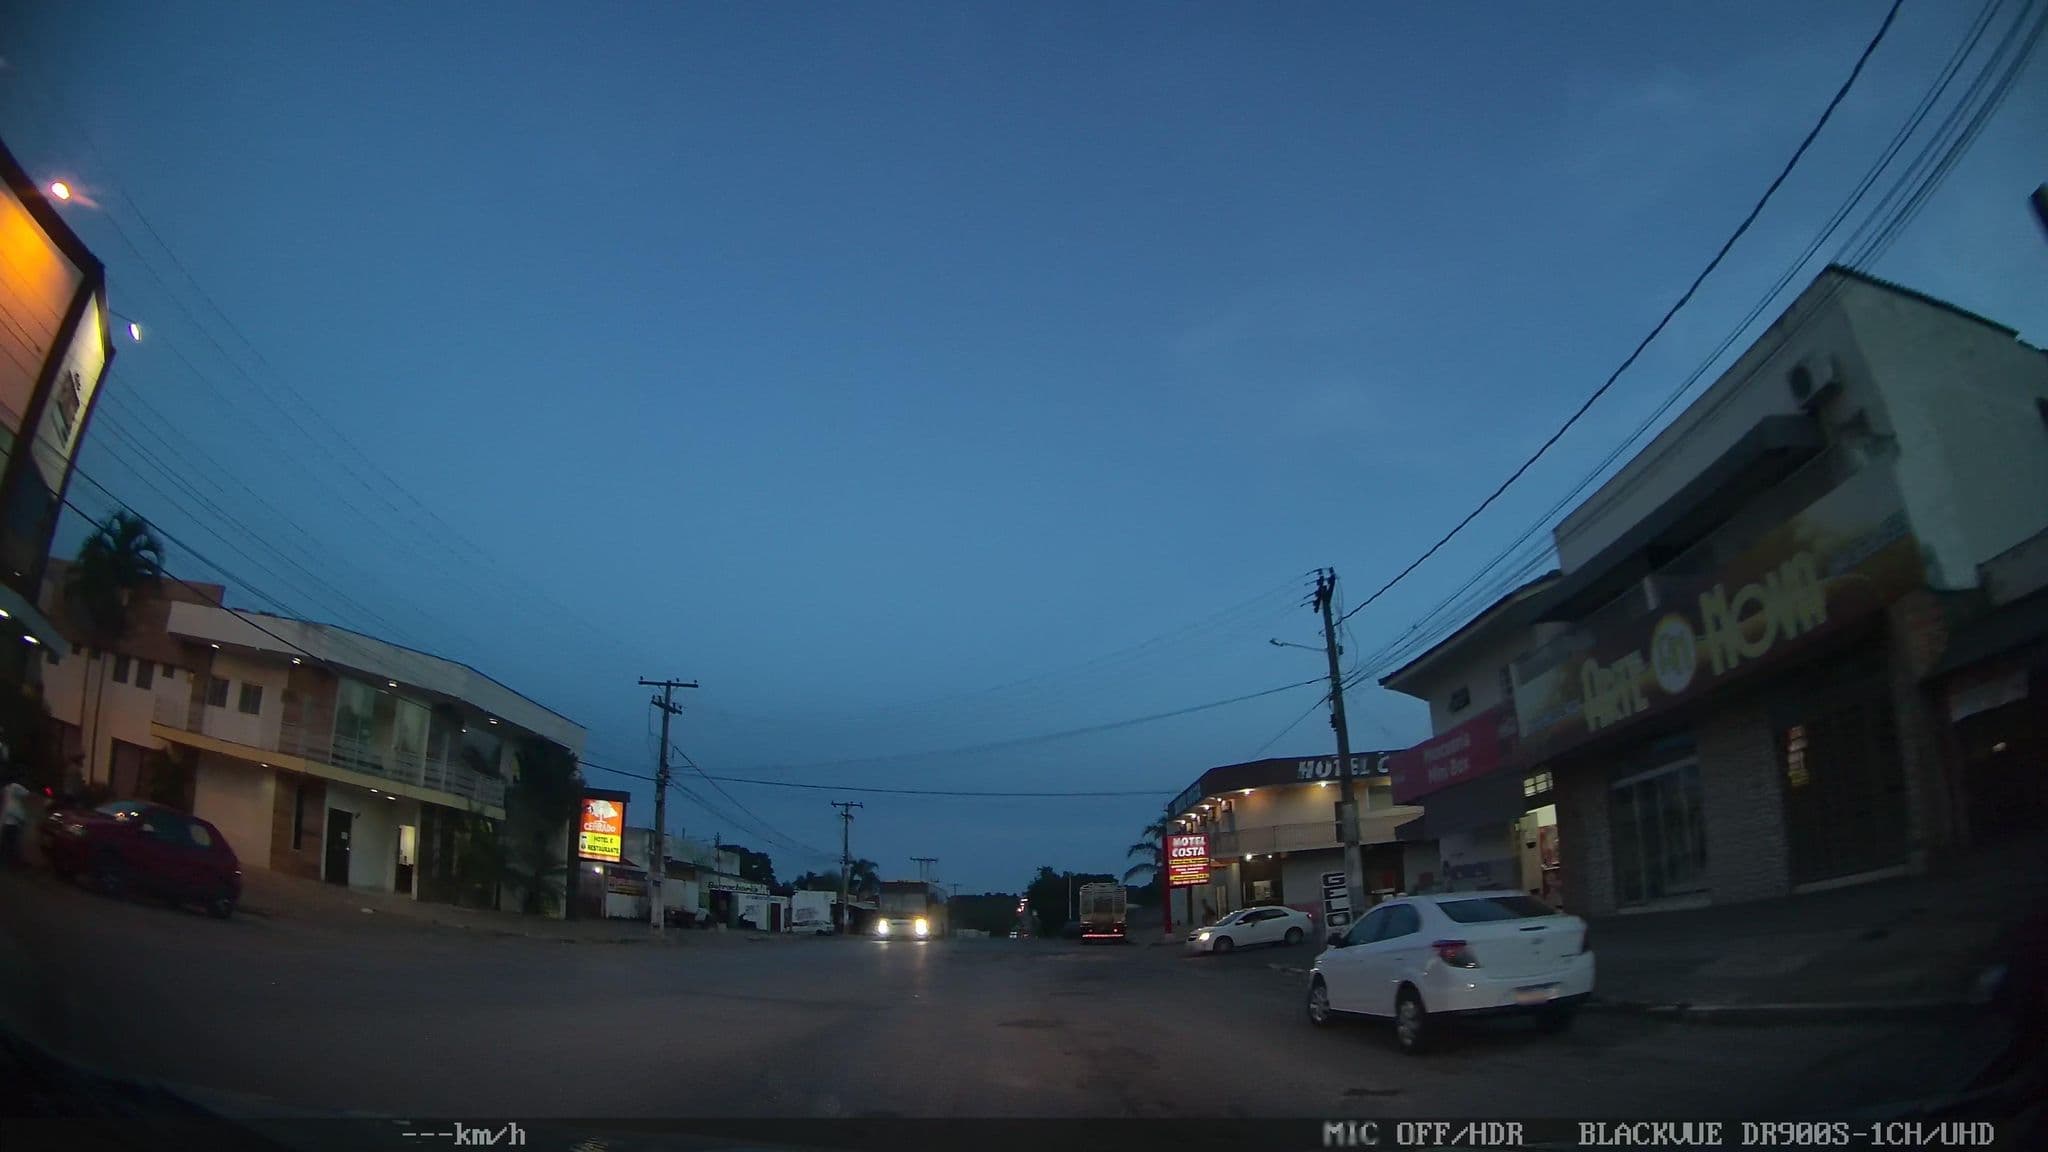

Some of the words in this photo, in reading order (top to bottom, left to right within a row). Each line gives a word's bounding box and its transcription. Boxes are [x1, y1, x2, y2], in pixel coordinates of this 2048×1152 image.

[1698, 551, 1827, 677] NOVA
[1173, 836, 1206, 847] HOTEL
[588, 844, 619, 854] RESTAURANTE
[1172, 846, 1206, 857] COSTA
[1322, 872, 1350, 928] GELO
